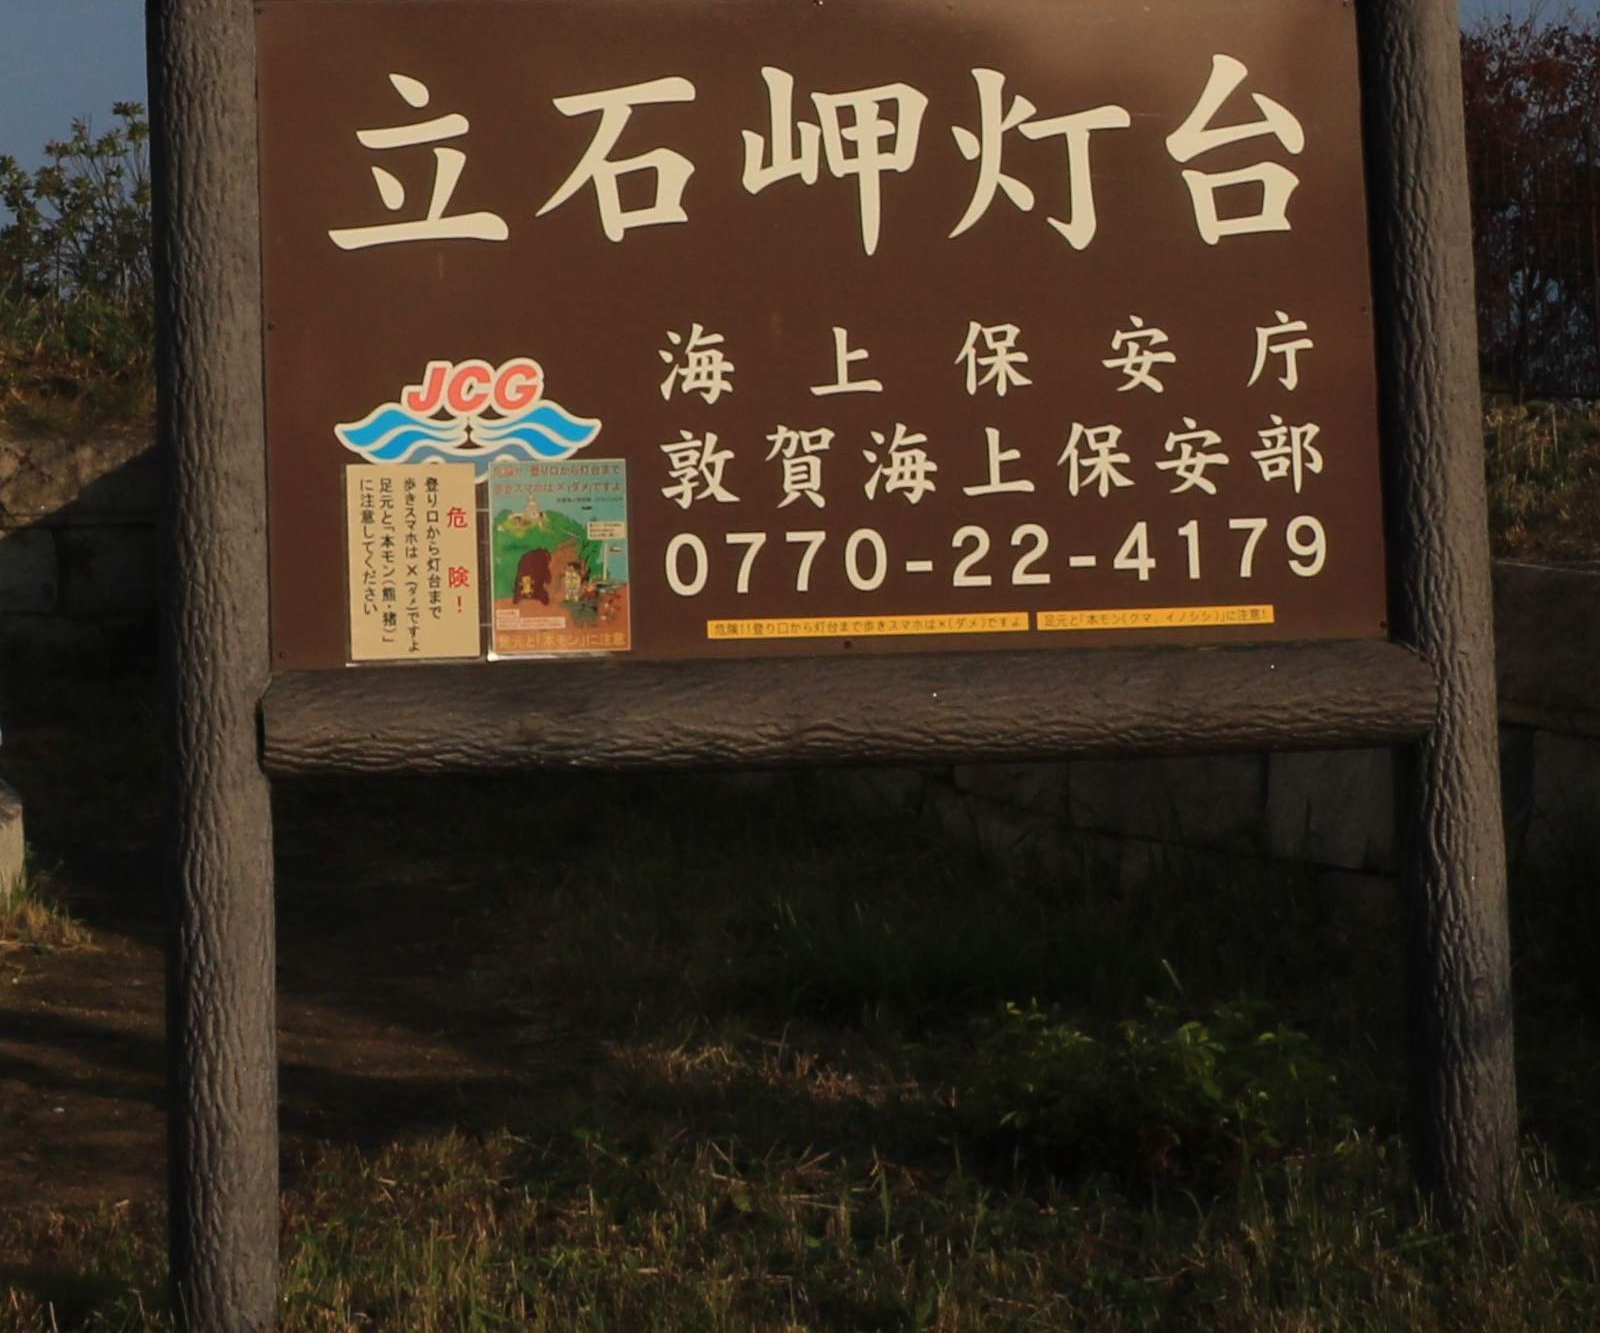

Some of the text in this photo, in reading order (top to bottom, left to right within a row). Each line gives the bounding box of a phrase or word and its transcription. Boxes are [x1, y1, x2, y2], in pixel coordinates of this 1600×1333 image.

[328, 54, 1306, 257] 立石岬灯台
[406, 364, 539, 413] JCG
[659, 311, 1316, 405] 海上保安庁
[659, 414, 1324, 508] 敦賀海上保安部
[360, 478, 378, 615] に注意してください
[424, 477, 443, 619] 登り口から灯台まで
[665, 517, 1328, 596] 0770-22-4179
